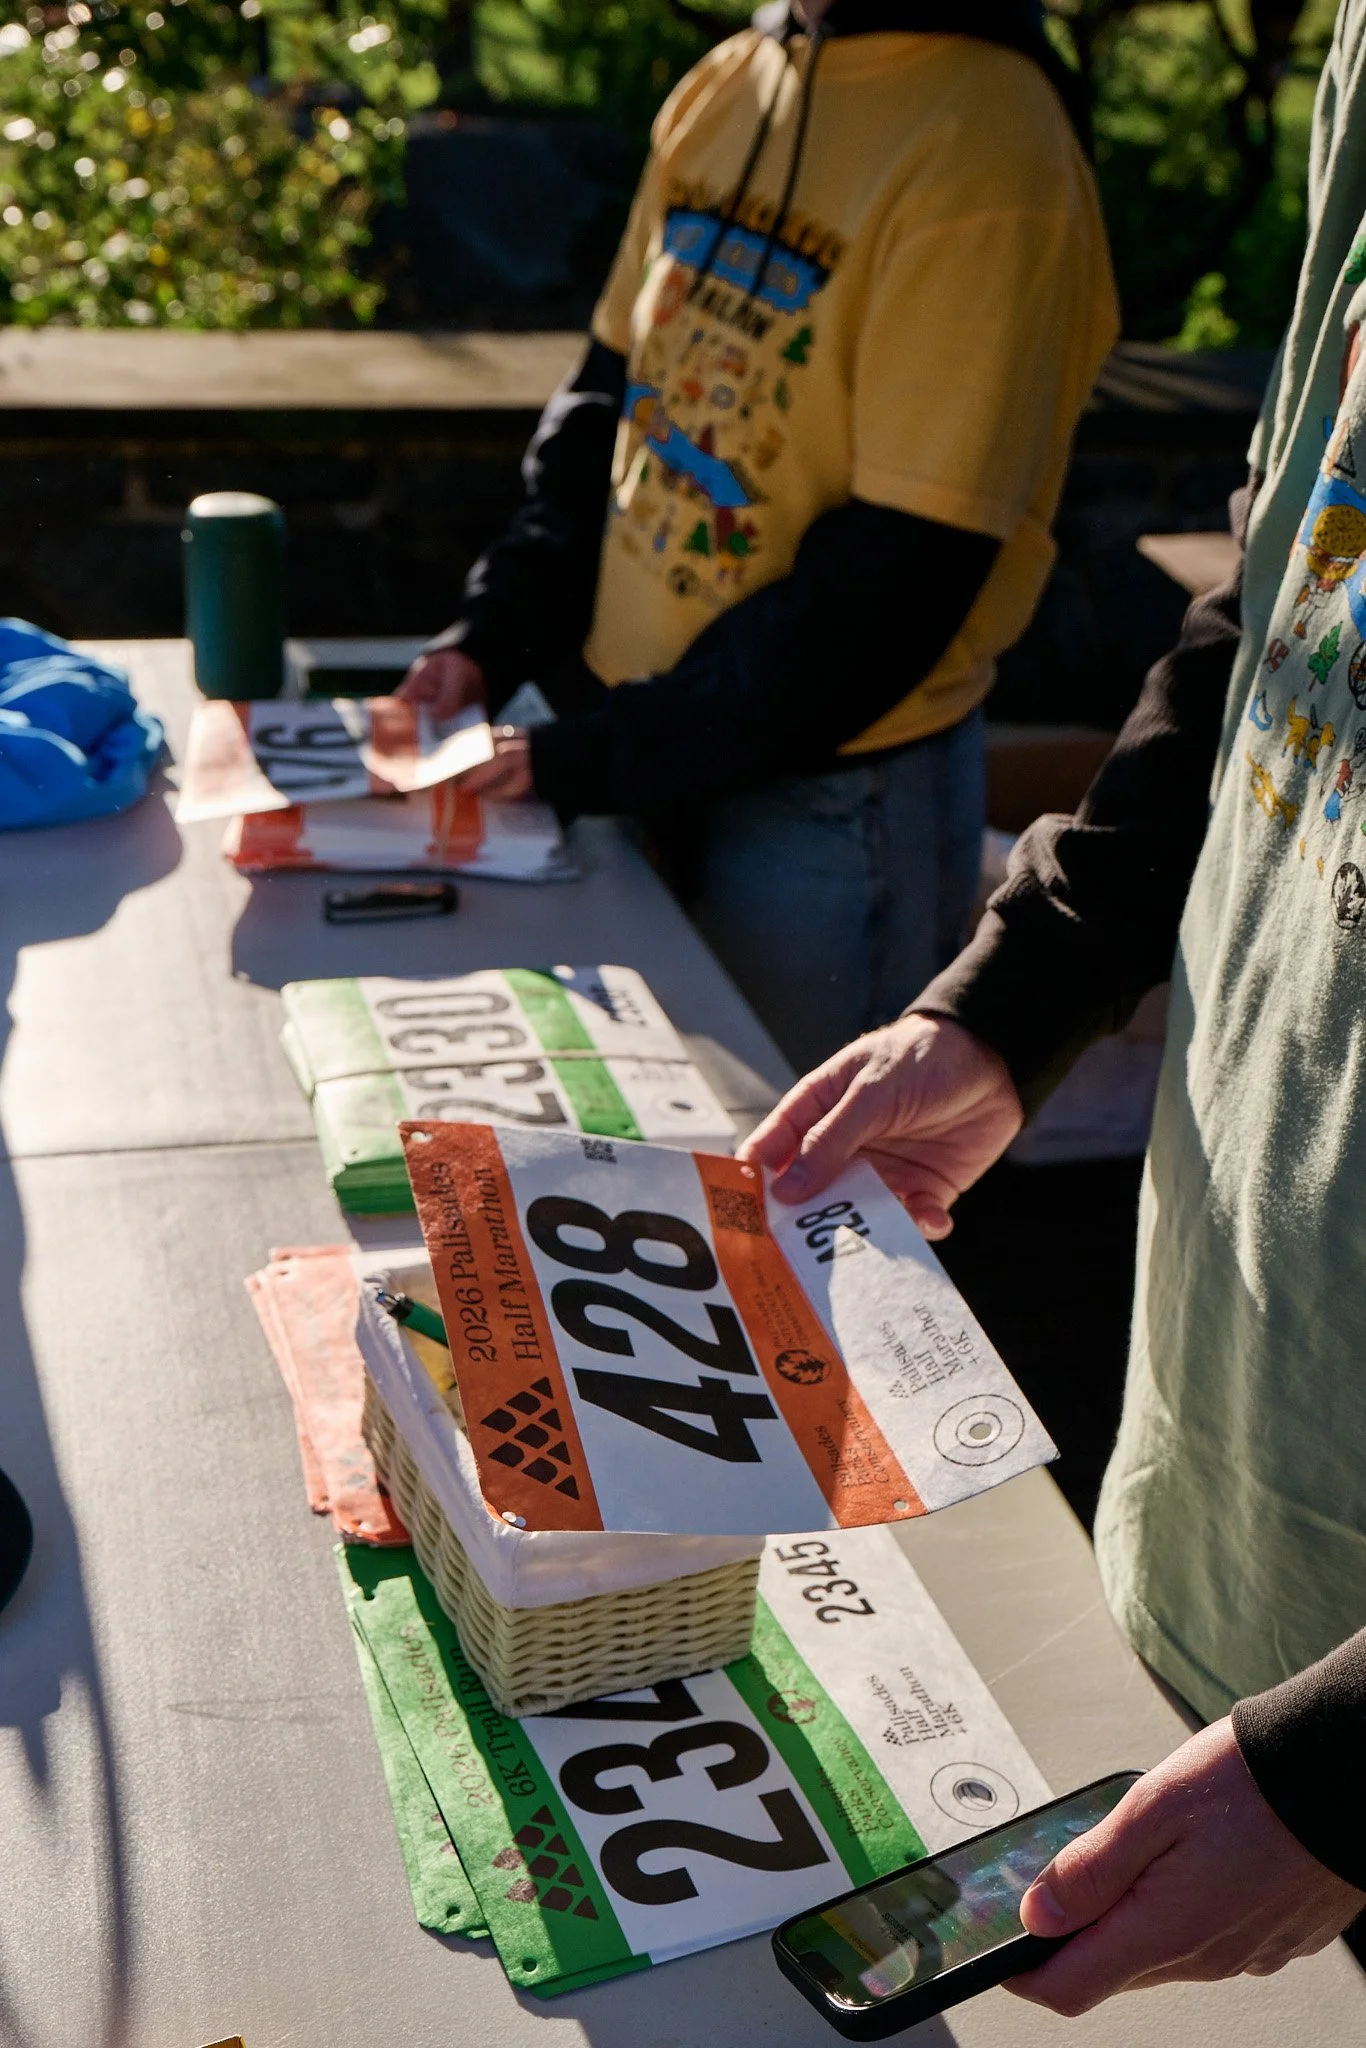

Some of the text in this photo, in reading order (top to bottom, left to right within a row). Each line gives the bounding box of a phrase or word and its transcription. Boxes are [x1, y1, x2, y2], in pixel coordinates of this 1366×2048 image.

[376, 992, 567, 1123] 2330
[429, 1162, 498, 1363] 2026 Palisades
[474, 1168, 543, 1361] Half Marathon
[795, 1201, 871, 1265] 428
[527, 1196, 779, 1463] 428
[878, 1319, 928, 1395] Palisades
[911, 1302, 965, 1377] Marathon
[912, 1349, 947, 1386] Half
[816, 1425, 851, 1489] Palisades
[773, 1540, 876, 1624] 2345
[401, 1624, 494, 1808] 2026 Palisades
[451, 1647, 537, 1797] 6K Trail Run
[867, 1673, 920, 1745] Palisades
[899, 1665, 954, 1738] Marathon
[904, 1708, 936, 1742] Half
[831, 1736, 895, 1831] Conservancy
[849, 1788, 880, 1834] Parks
